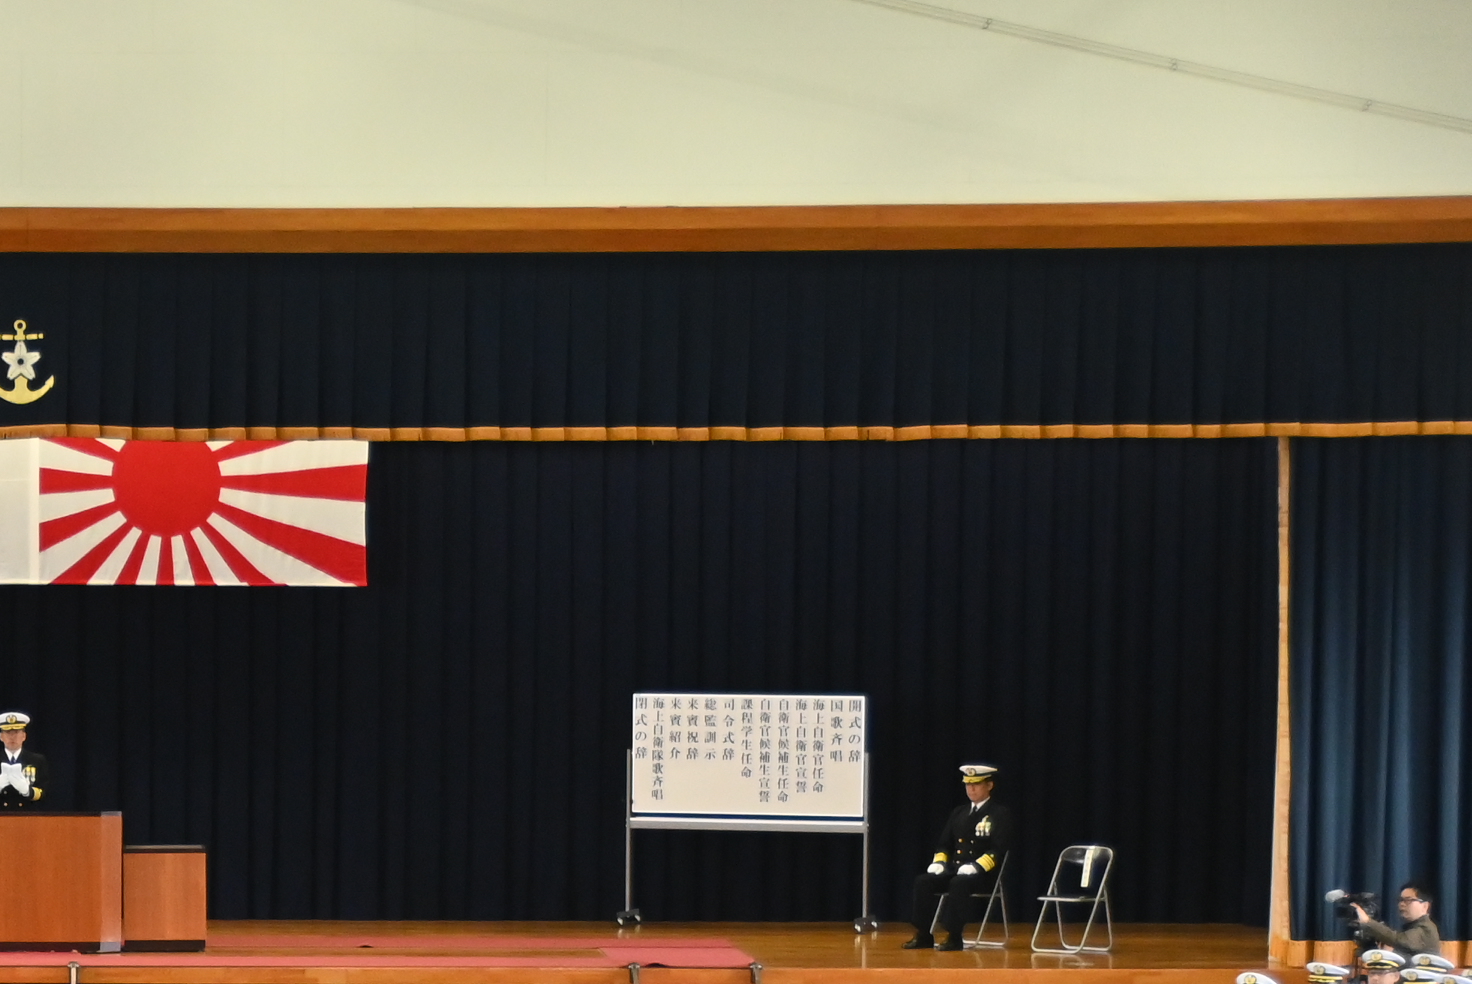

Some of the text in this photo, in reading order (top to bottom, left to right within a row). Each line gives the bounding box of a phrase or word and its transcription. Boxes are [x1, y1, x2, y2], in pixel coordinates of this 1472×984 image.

[635, 697, 648, 760] 閉式の辞
[652, 697, 664, 801] 海上自衛隊歌斉唱
[704, 698, 717, 760] 総監訓示
[722, 698, 735, 760] 司令式辞
[741, 698, 753, 778] 課程学生任命
[759, 698, 772, 803] 自衛官候補生宣誓
[777, 698, 790, 803] 自衛官候補生任命
[795, 699, 807, 793] 海上自衛官宣誓
[812, 699, 824, 793] 海上自衛官任命
[830, 699, 843, 763] 国歌斉唱
[848, 699, 862, 763] 開式の辞
